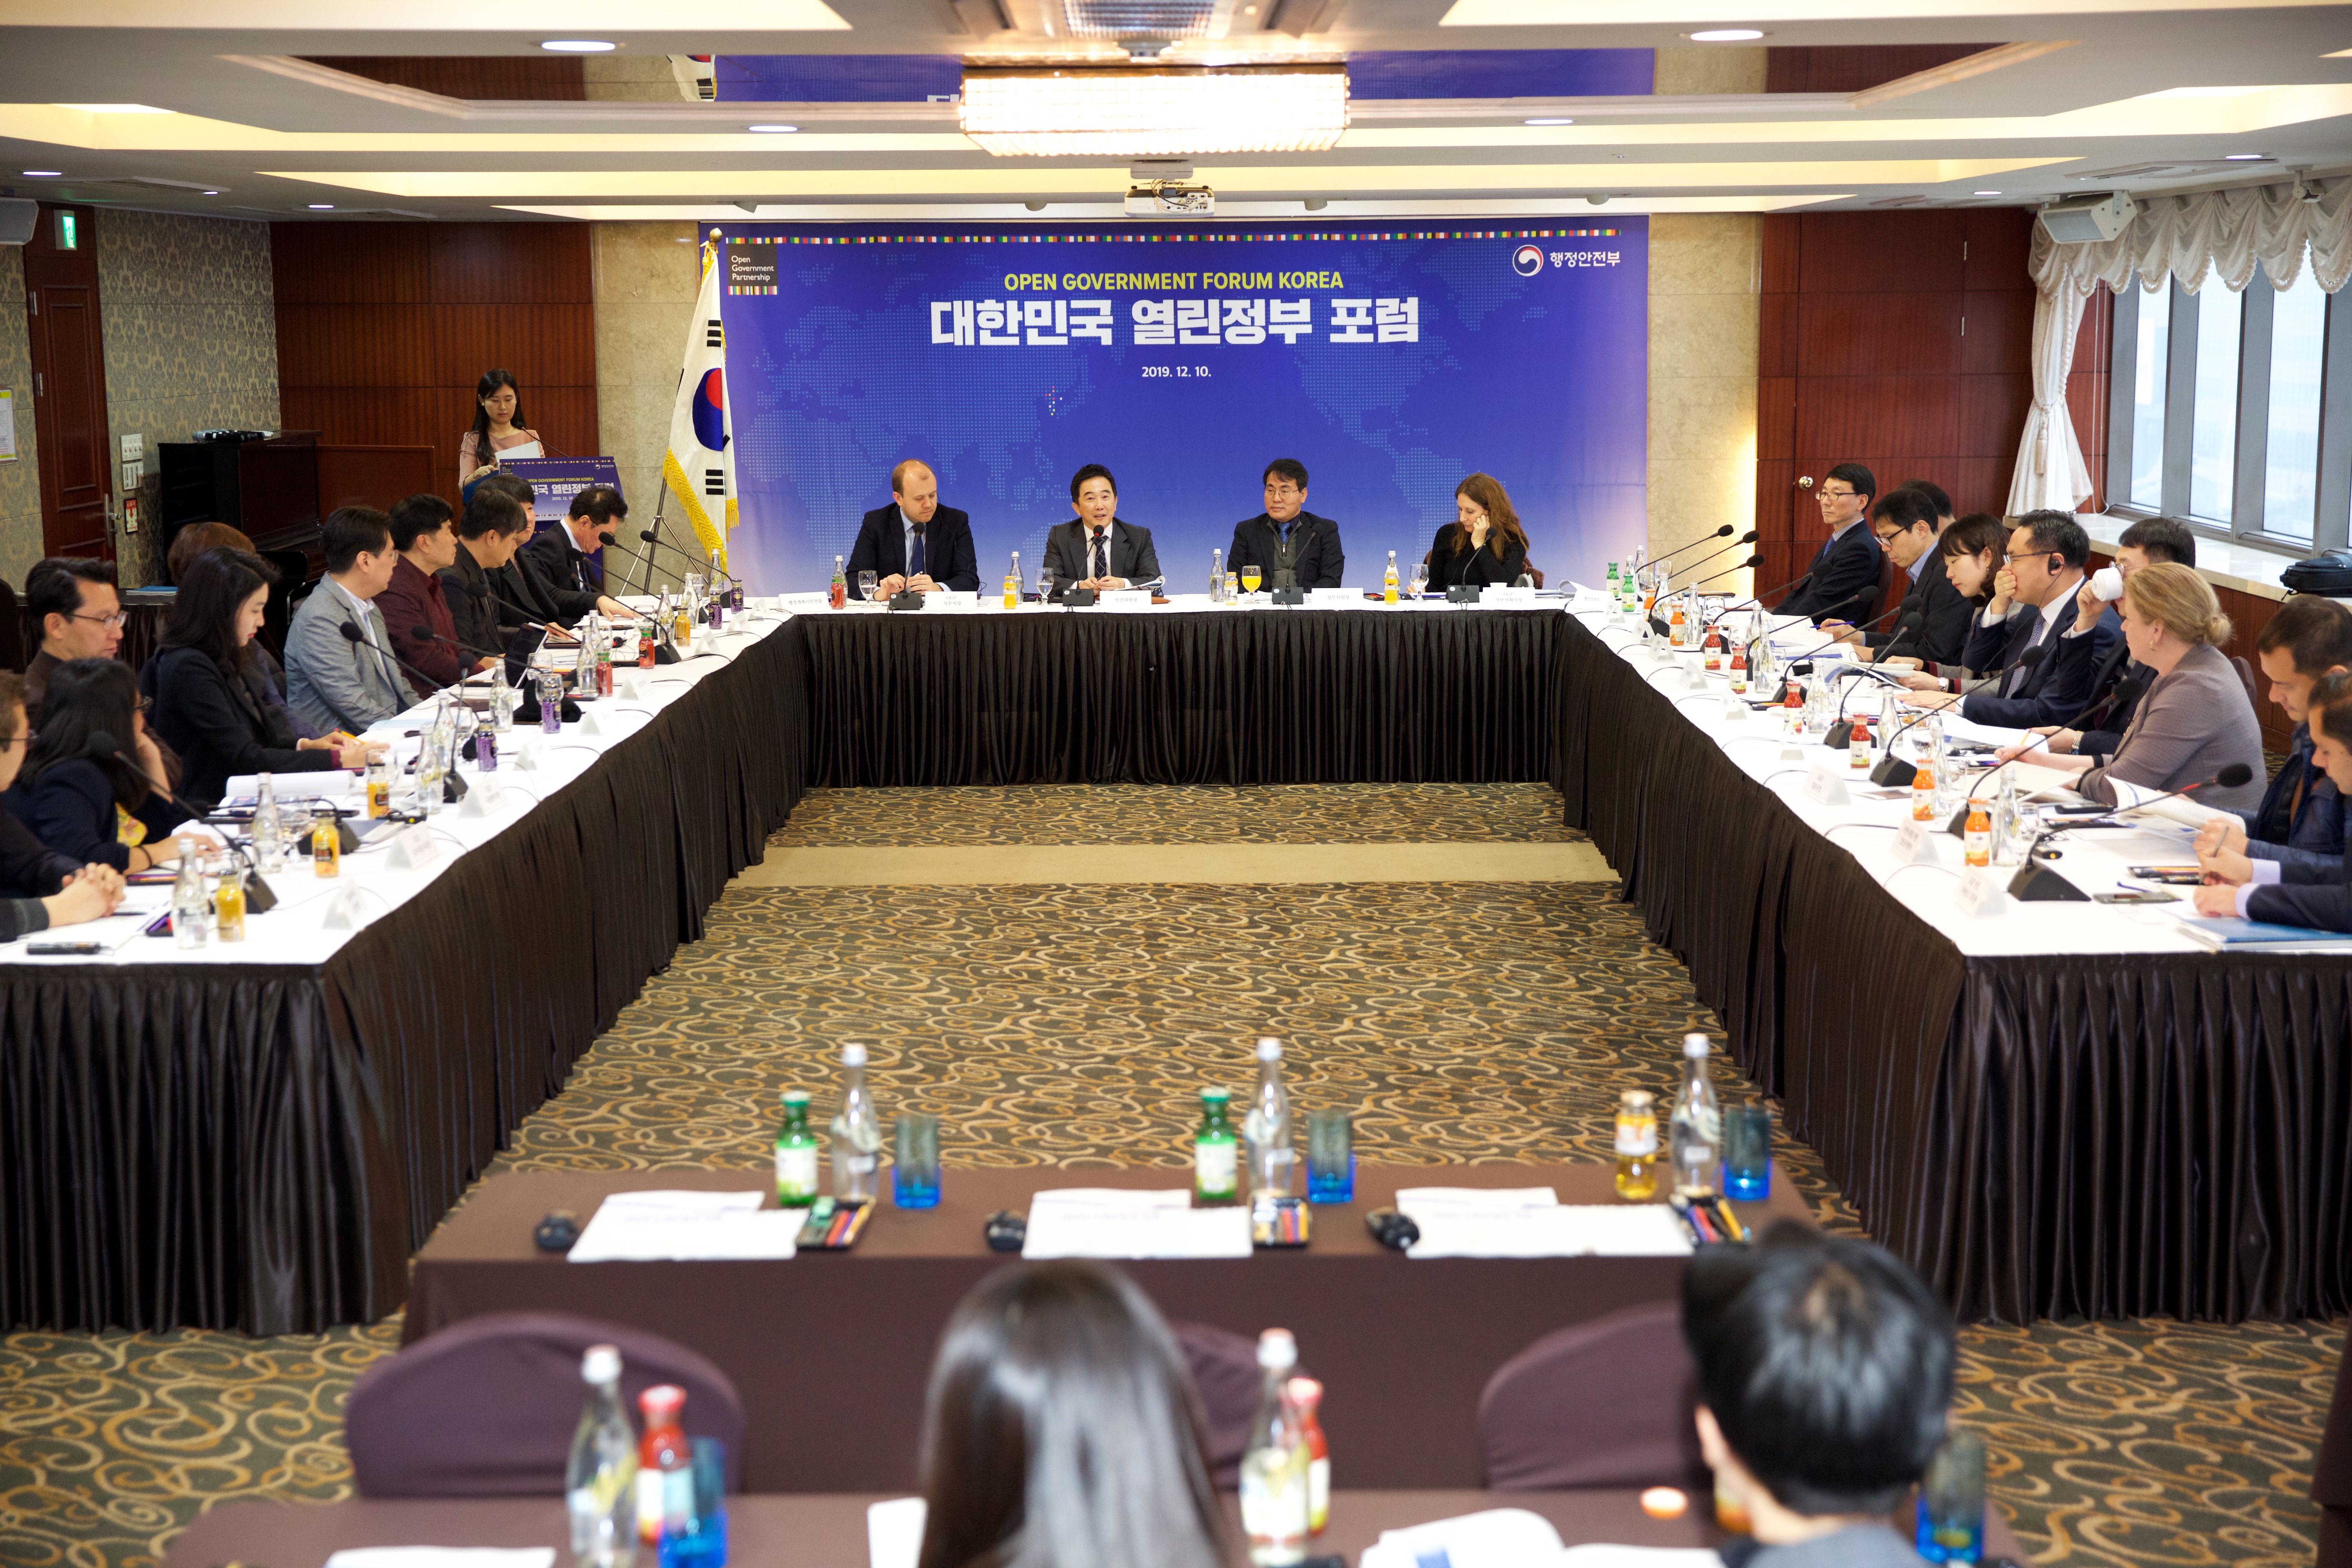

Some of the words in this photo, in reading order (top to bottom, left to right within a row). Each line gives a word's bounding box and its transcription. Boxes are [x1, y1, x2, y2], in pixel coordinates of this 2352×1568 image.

[731, 255, 751, 264] Open
[1550, 251, 1621, 268] 행정안전부
[732, 273, 771, 282] Partnership
[1004, 274, 1057, 291] OPEN
[1062, 273, 1197, 290] GOVERNMENT
[1203, 272, 1272, 289] FORUM
[1279, 271, 1344, 289] KOREA
[931, 299, 1114, 345] 대한민국
[1131, 298, 1312, 345] 열린정부
[1330, 297, 1419, 343] 포럼
[1142, 366, 1172, 377] 2019.
[1176, 366, 1192, 377] 12.
[1195, 366, 1212, 377] 10.
